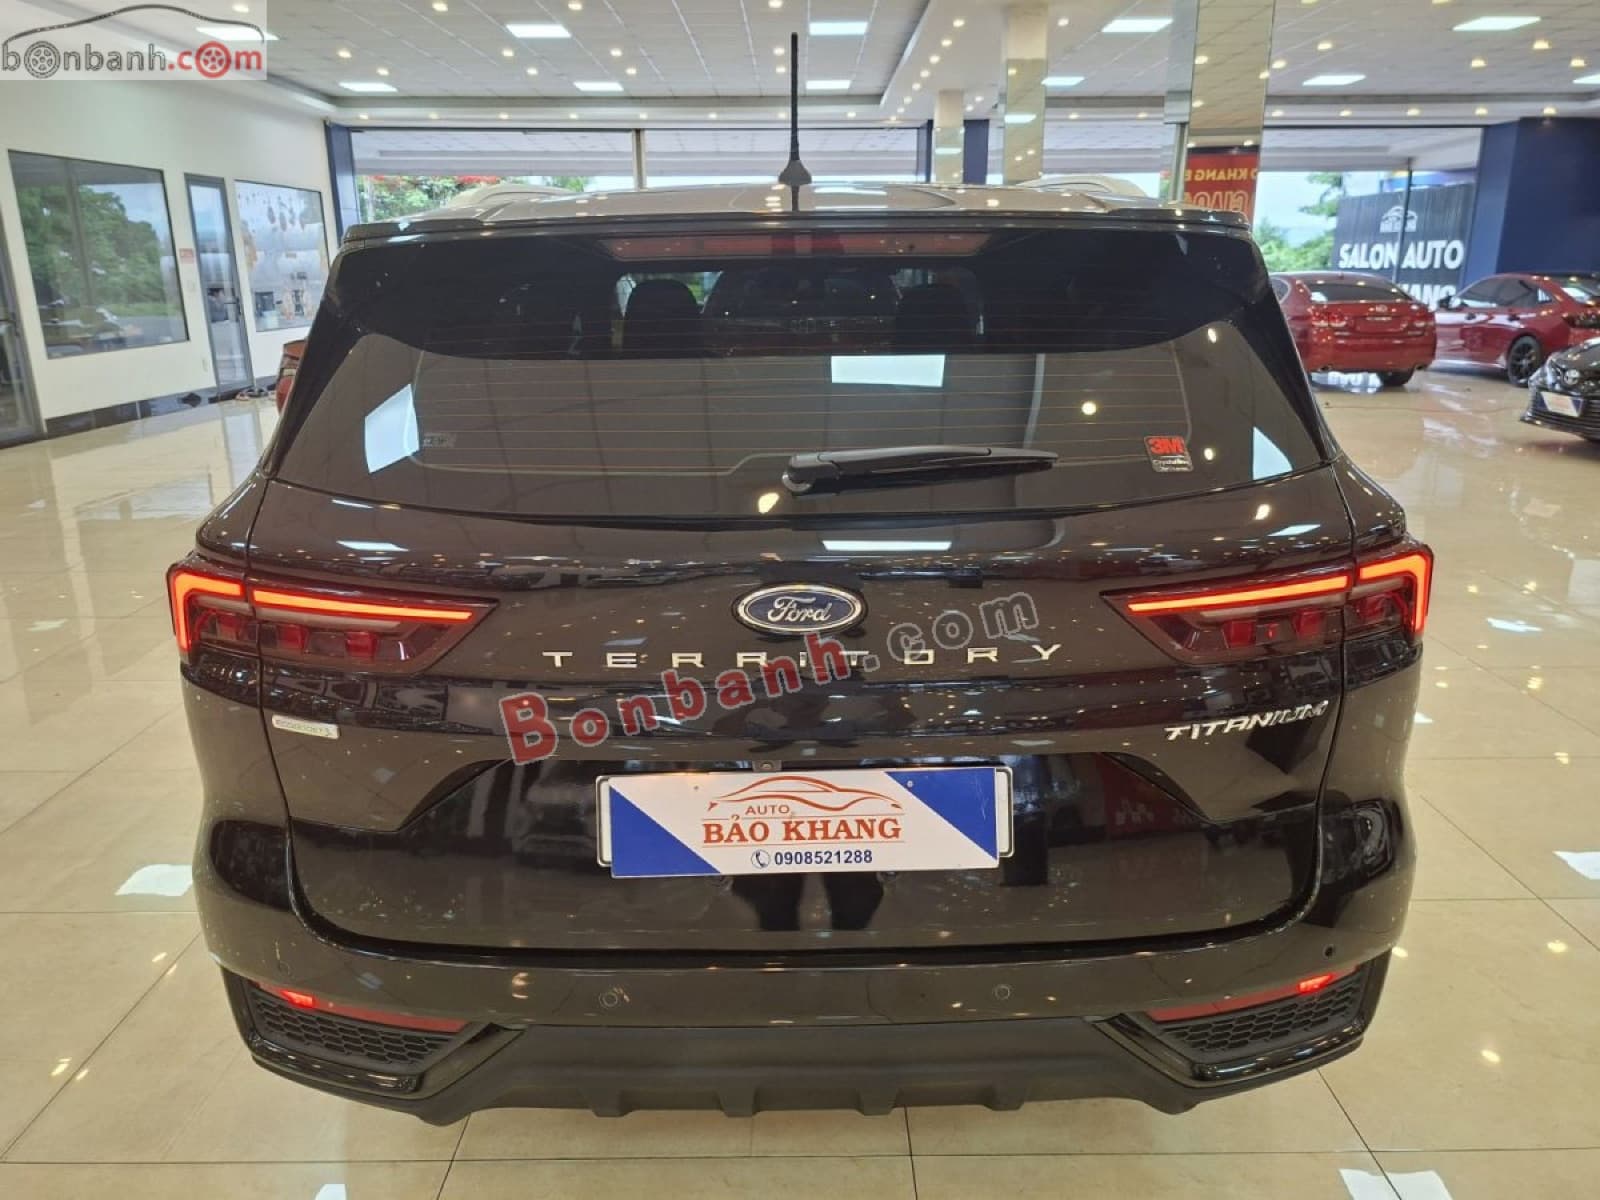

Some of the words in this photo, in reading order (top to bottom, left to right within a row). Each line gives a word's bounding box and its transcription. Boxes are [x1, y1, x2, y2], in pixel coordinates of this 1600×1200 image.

[1338, 242, 1399, 270] SALON
[1401, 240, 1464, 270] AUTO
[1149, 438, 1185, 455] 3M
[768, 596, 832, 621] Ford
[543, 643, 1061, 668] TERRITORY
[1164, 700, 1328, 740] TITANIUM
[745, 804, 790, 815] AUTO
[703, 815, 769, 843] BẢO
[782, 818, 901, 841] KHANG
[774, 850, 872, 865] 0908521288
